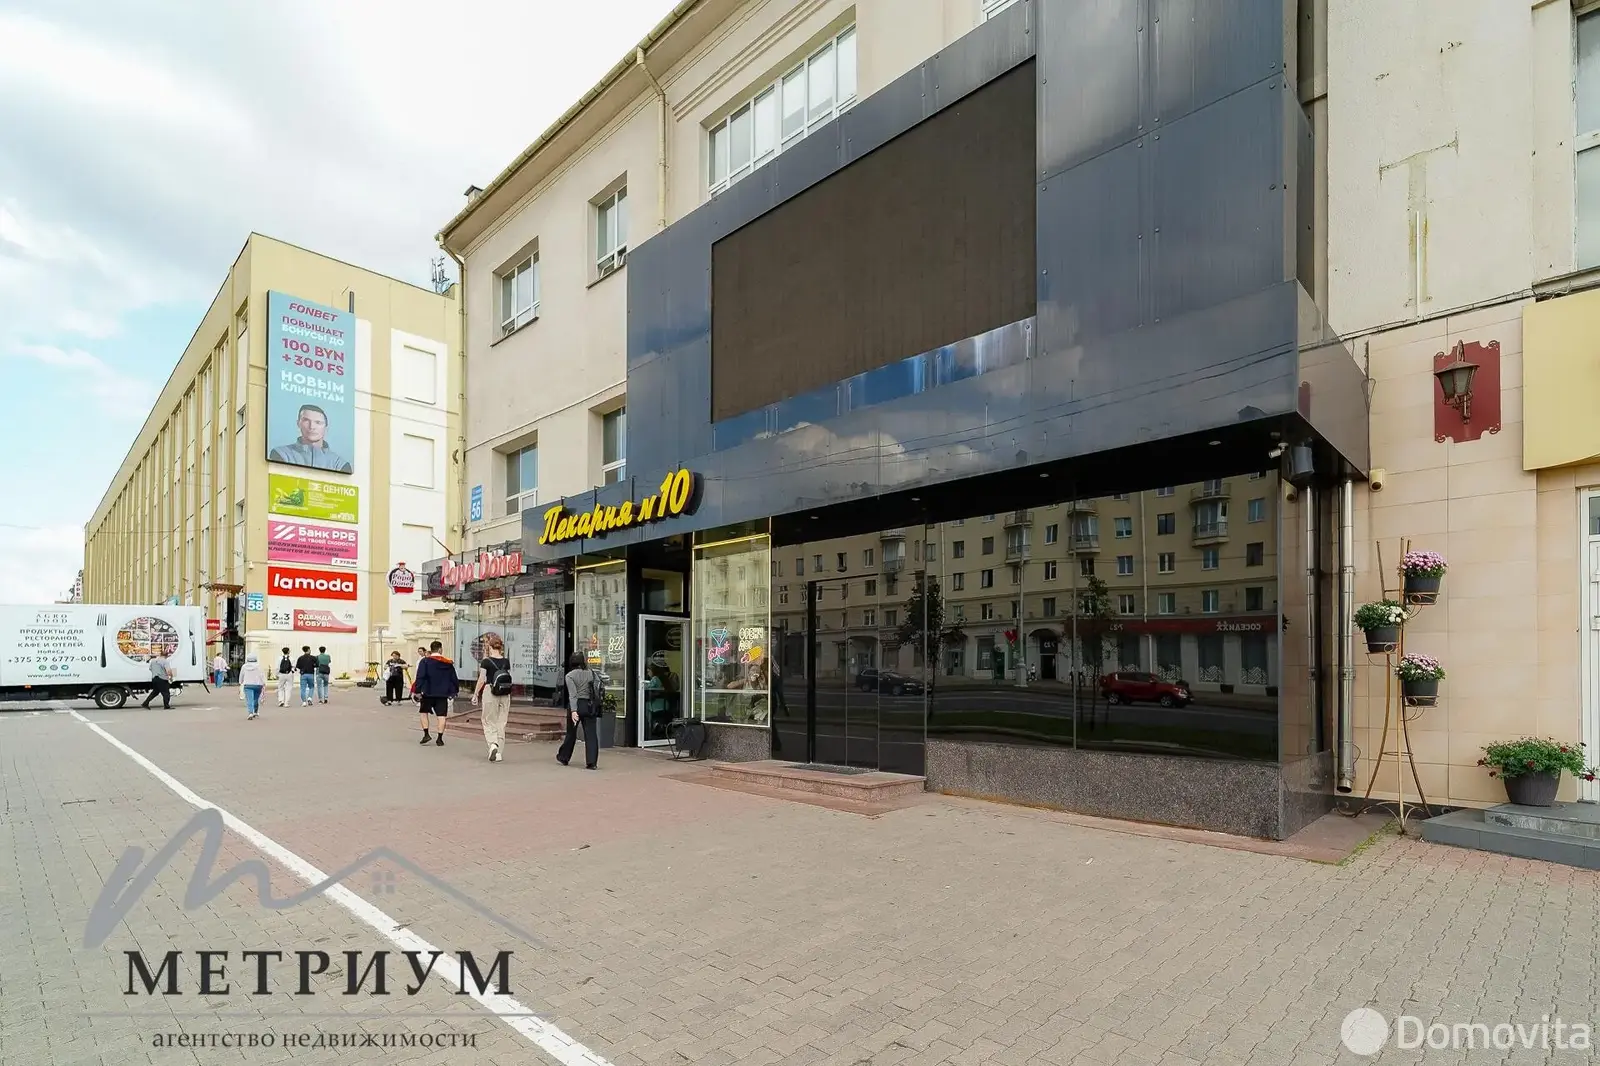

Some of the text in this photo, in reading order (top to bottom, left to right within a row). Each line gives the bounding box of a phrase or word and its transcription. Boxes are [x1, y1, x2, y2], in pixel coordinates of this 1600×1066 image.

[289, 302, 338, 322] FONBET
[281, 323, 345, 347] БОНУСЫ ДО
[282, 315, 345, 338] ПОВЫШАЕТ
[281, 337, 345, 363] 100 BYN
[293, 354, 324, 371] 300
[327, 363, 345, 376] FS
[281, 369, 345, 394] НОВЫМ
[280, 382, 345, 404] КЛИЕНТАМ
[471, 501, 482, 520] 56
[538, 500, 633, 545] Пекарня
[298, 526, 356, 541] Банк РРБ
[274, 573, 354, 593] lamoda
[440, 559, 475, 592] Papa
[248, 600, 264, 611] 58
[272, 612, 278, 620] 2
[284, 612, 290, 620] 3
[297, 613, 333, 621] ОДЕЖДА
[52, 655, 99, 663] 6777-001
